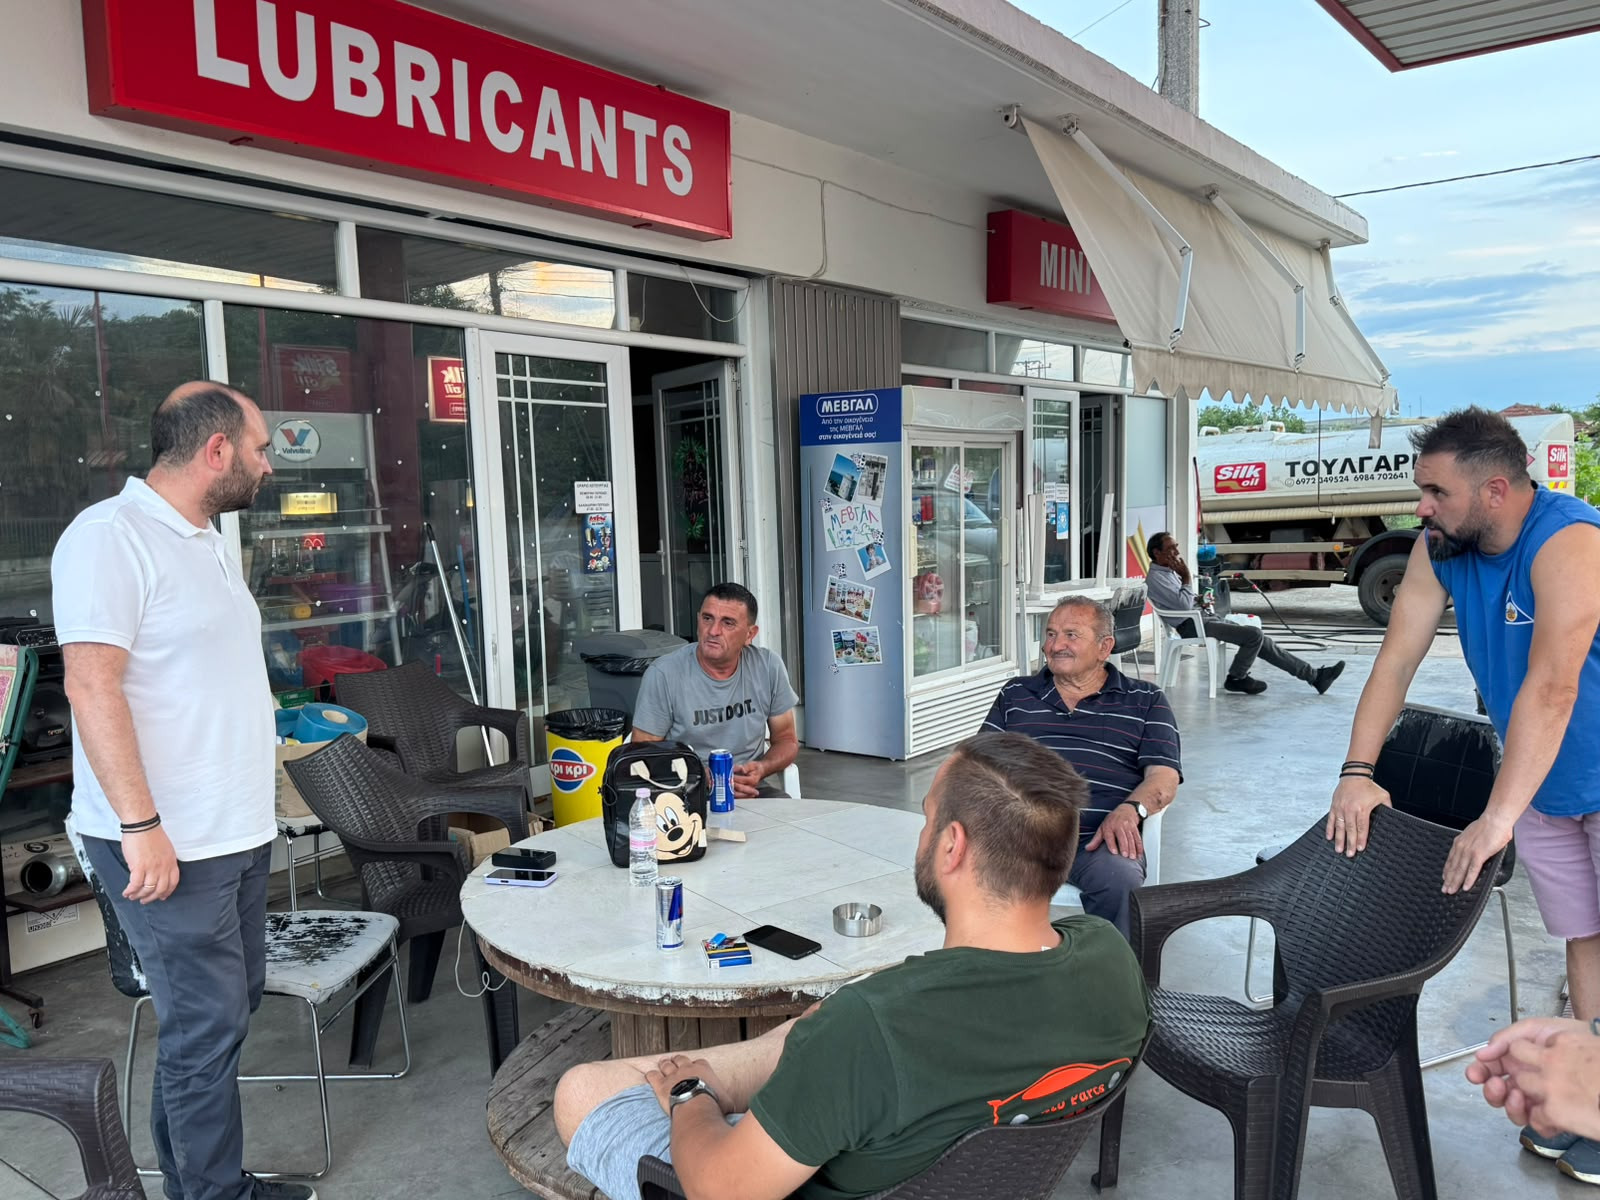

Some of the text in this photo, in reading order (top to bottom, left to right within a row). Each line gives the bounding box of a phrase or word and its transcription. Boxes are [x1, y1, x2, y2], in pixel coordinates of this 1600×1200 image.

[193, 0, 694, 197] LUBRICANTS
[1039, 240, 1091, 296] MINI
[821, 398, 874, 413] ΜΕΒΓΑΛ
[840, 424, 864, 432] ΜΕΒΓΑΛ
[1549, 447, 1567, 463] Silk
[1216, 464, 1263, 480] Silk
[1295, 477, 1316, 485] 6972
[1353, 472, 1375, 482] 6984
[1377, 471, 1409, 481] 702641
[1241, 478, 1260, 487] oil
[831, 504, 879, 532] ΜΕΒΓΑΛ
[693, 708, 724, 726] JUST
[725, 702, 744, 720] DO
